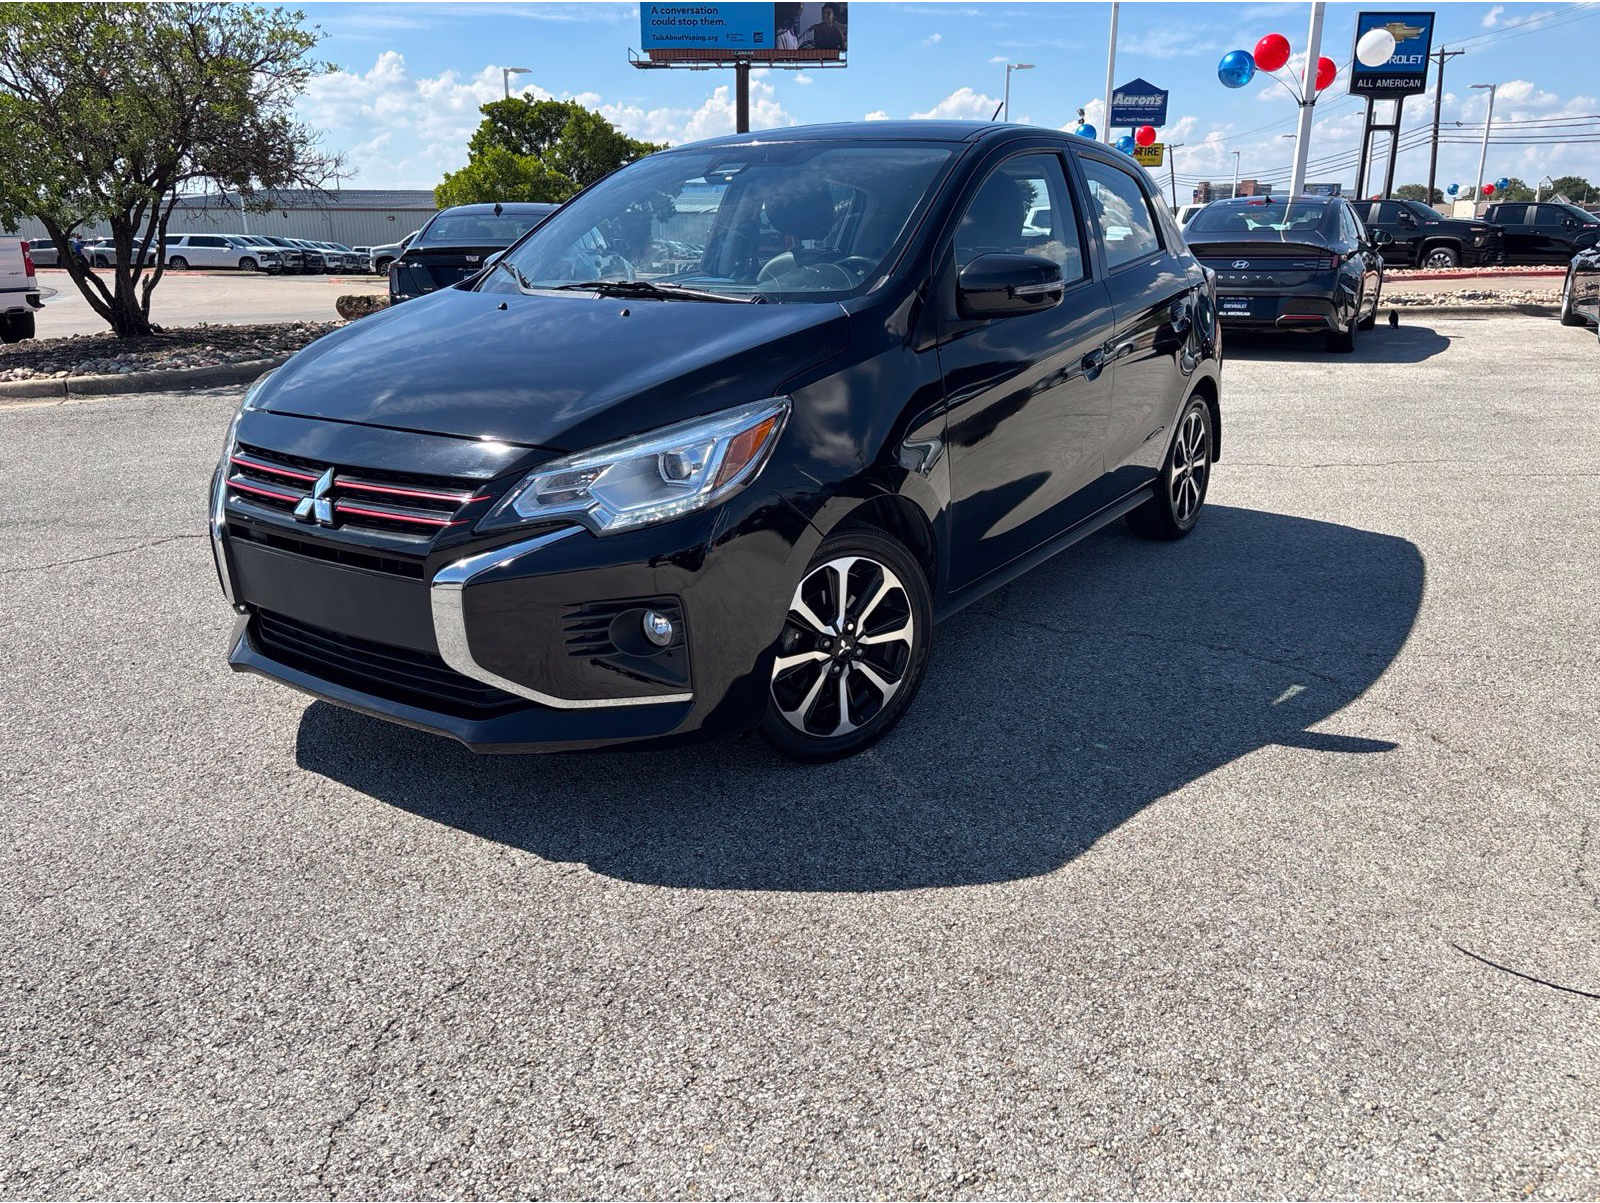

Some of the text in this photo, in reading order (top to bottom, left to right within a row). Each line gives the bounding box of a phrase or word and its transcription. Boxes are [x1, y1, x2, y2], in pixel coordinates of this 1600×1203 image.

[651, 6, 719, 15] A conversation
[651, 16, 728, 28] could stop them.
[1357, 79, 1421, 88] ALL AMERICAN
[1113, 93, 1163, 105] Aaron's
[1138, 146, 1160, 156] TIRE
